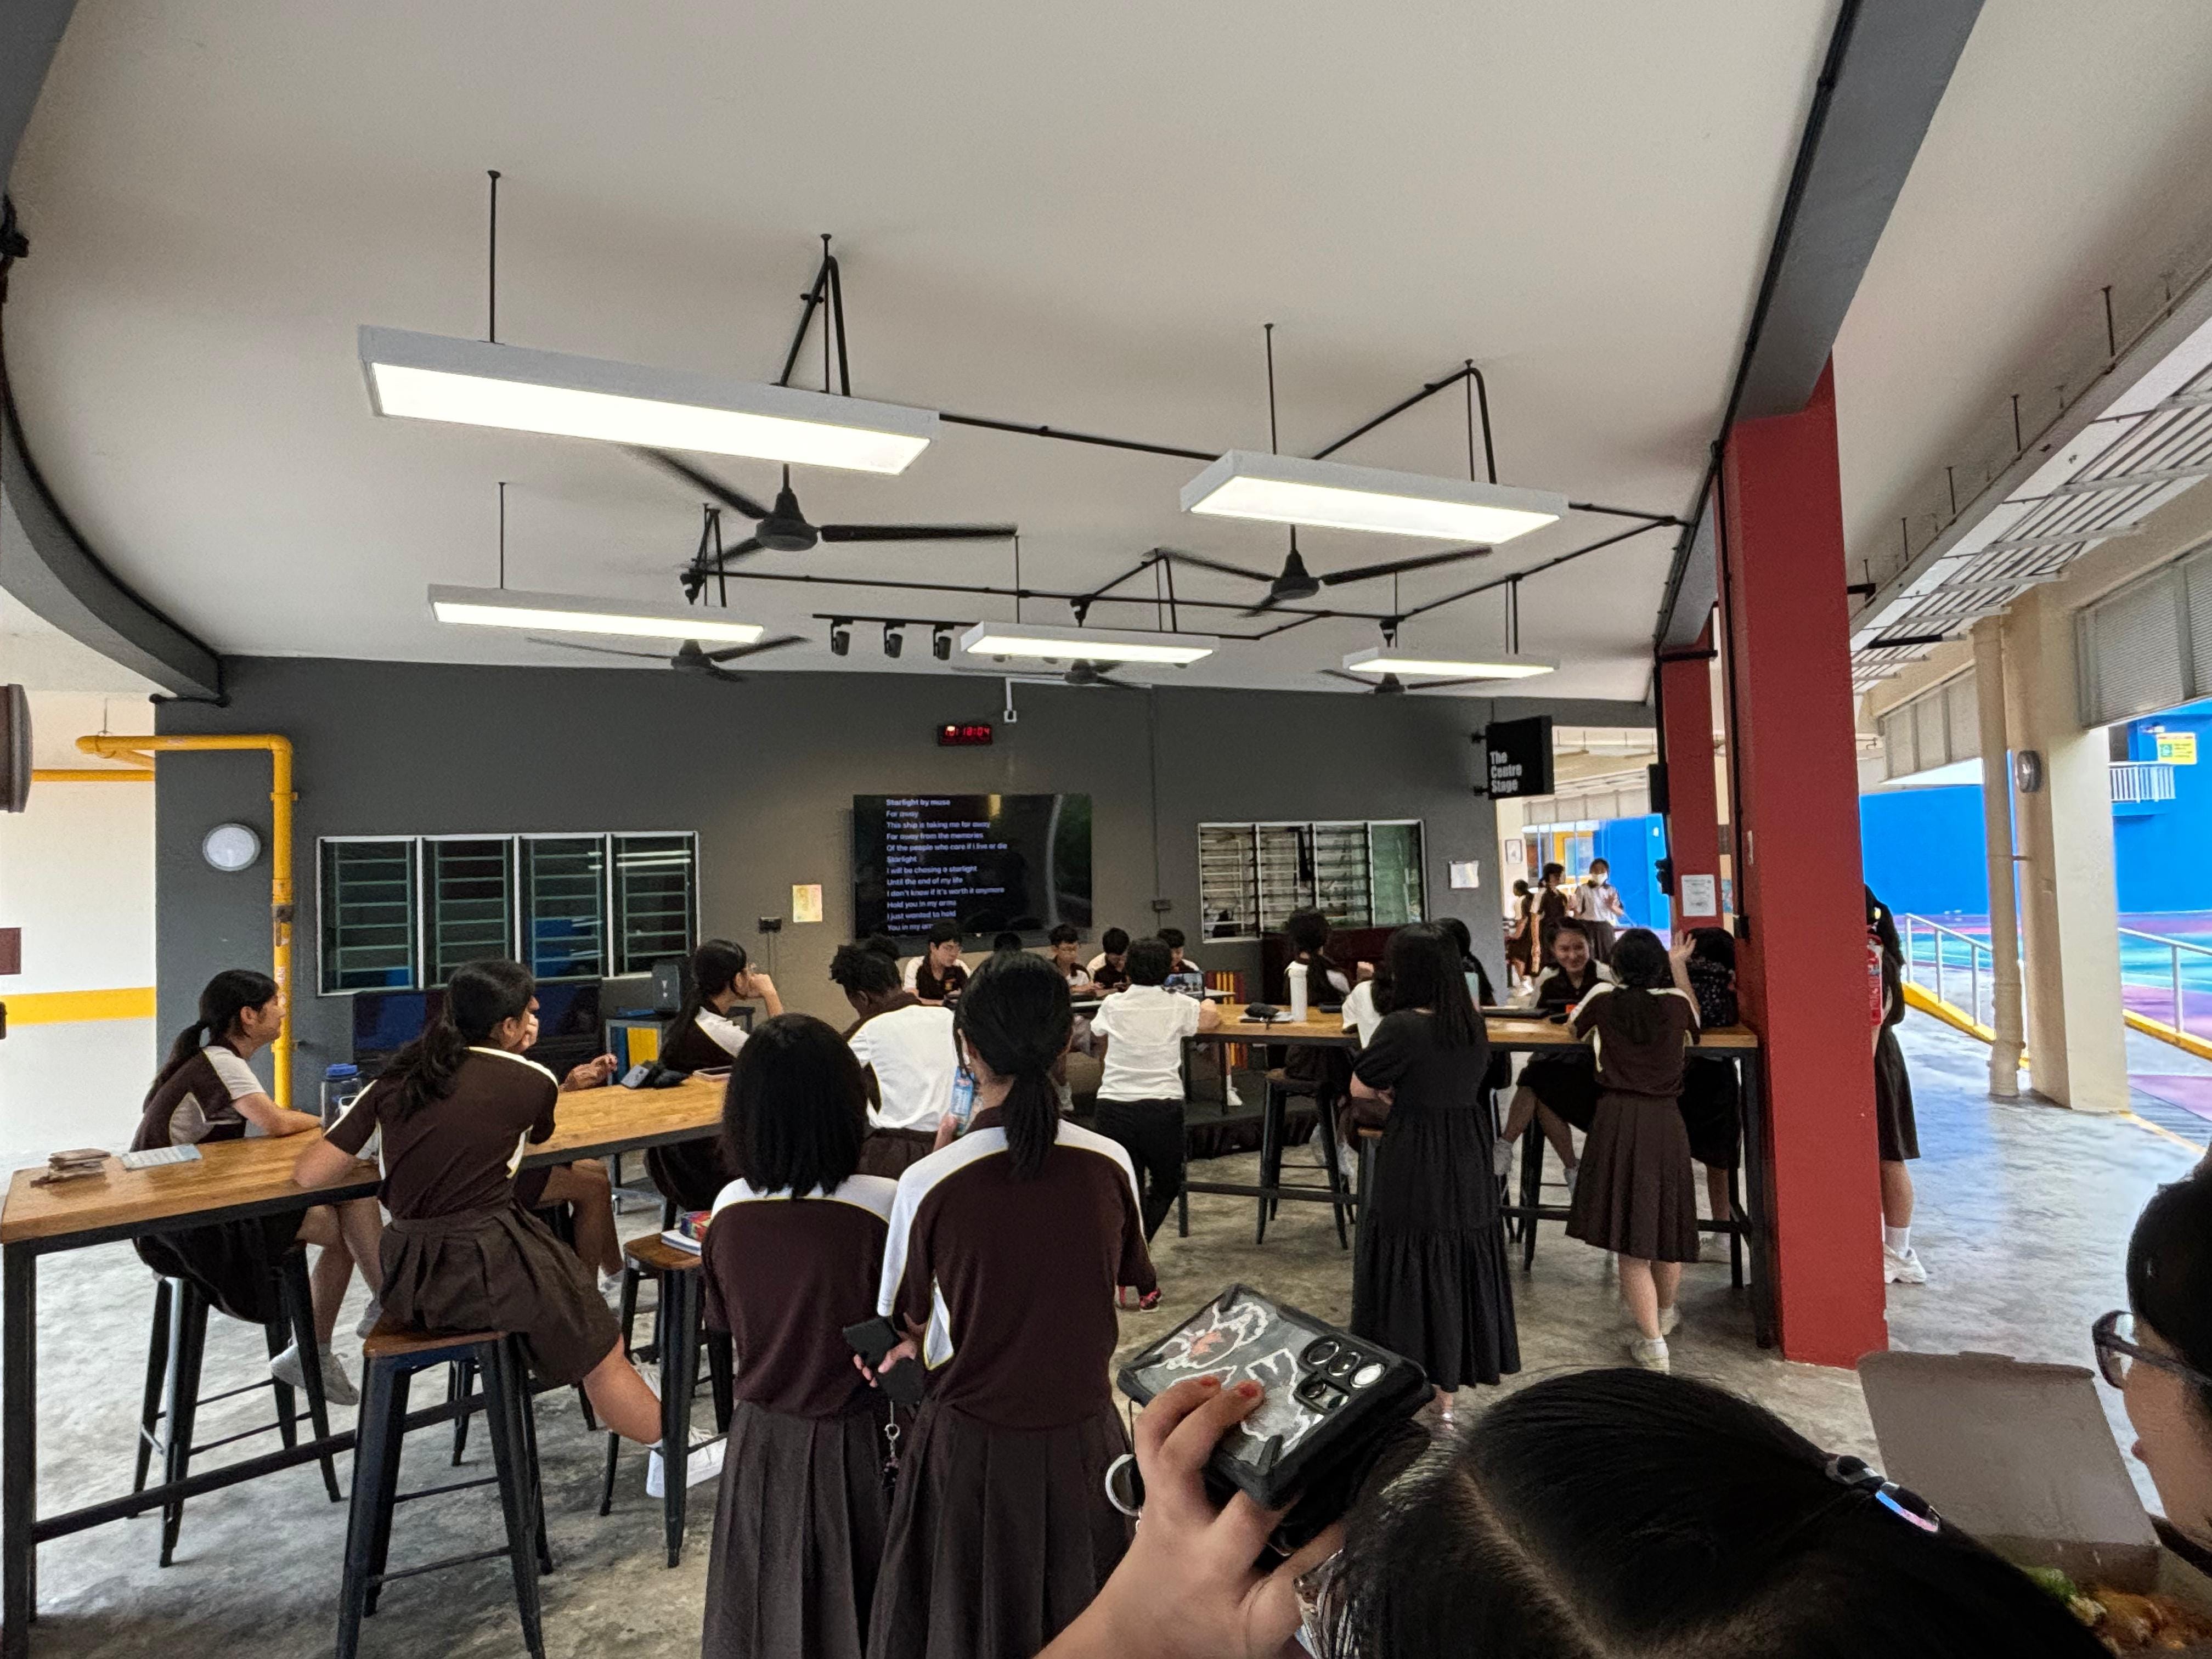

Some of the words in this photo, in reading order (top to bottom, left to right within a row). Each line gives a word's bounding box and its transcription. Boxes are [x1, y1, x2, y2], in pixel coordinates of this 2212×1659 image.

[1490, 751, 1508, 764] The
[1491, 764, 1522, 779] Centre
[1491, 779, 1518, 793] Stage
[886, 799, 918, 807] Starlight
